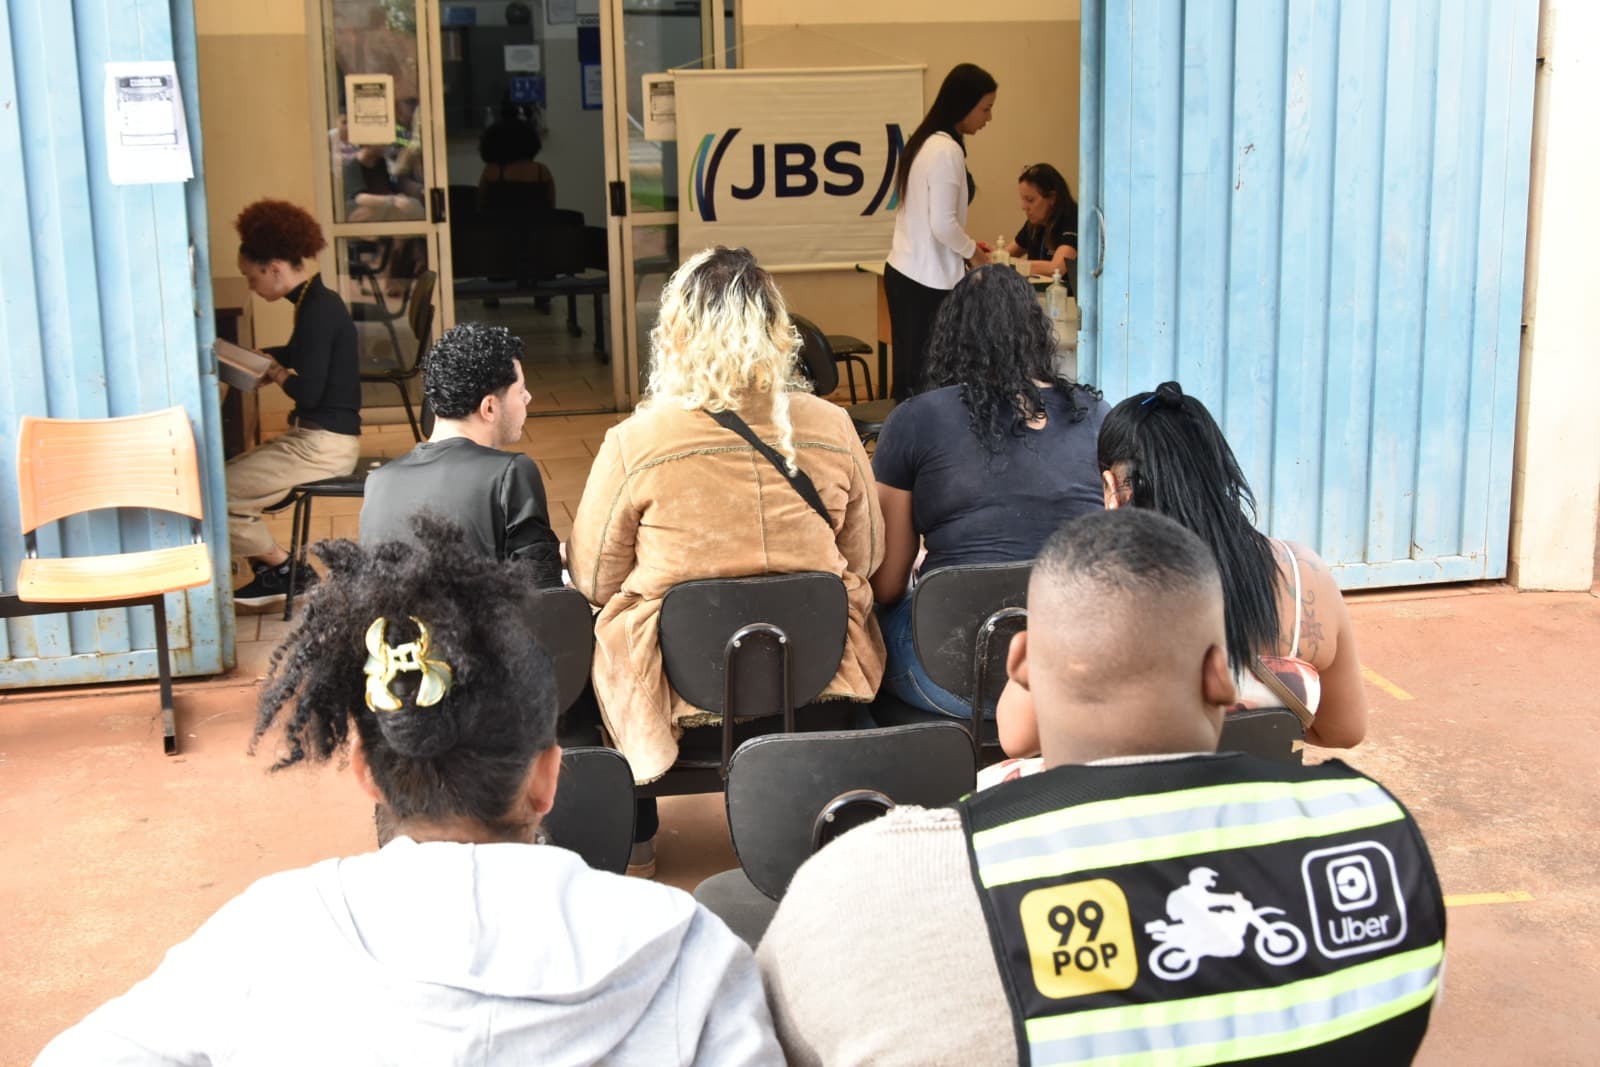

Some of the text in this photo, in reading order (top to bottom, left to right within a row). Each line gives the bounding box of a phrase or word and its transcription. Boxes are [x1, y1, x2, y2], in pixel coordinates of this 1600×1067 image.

[731, 141, 864, 200] JBS
[1047, 900, 1104, 947] 99
[1328, 914, 1390, 945] Uber
[1052, 942, 1119, 976] POP
